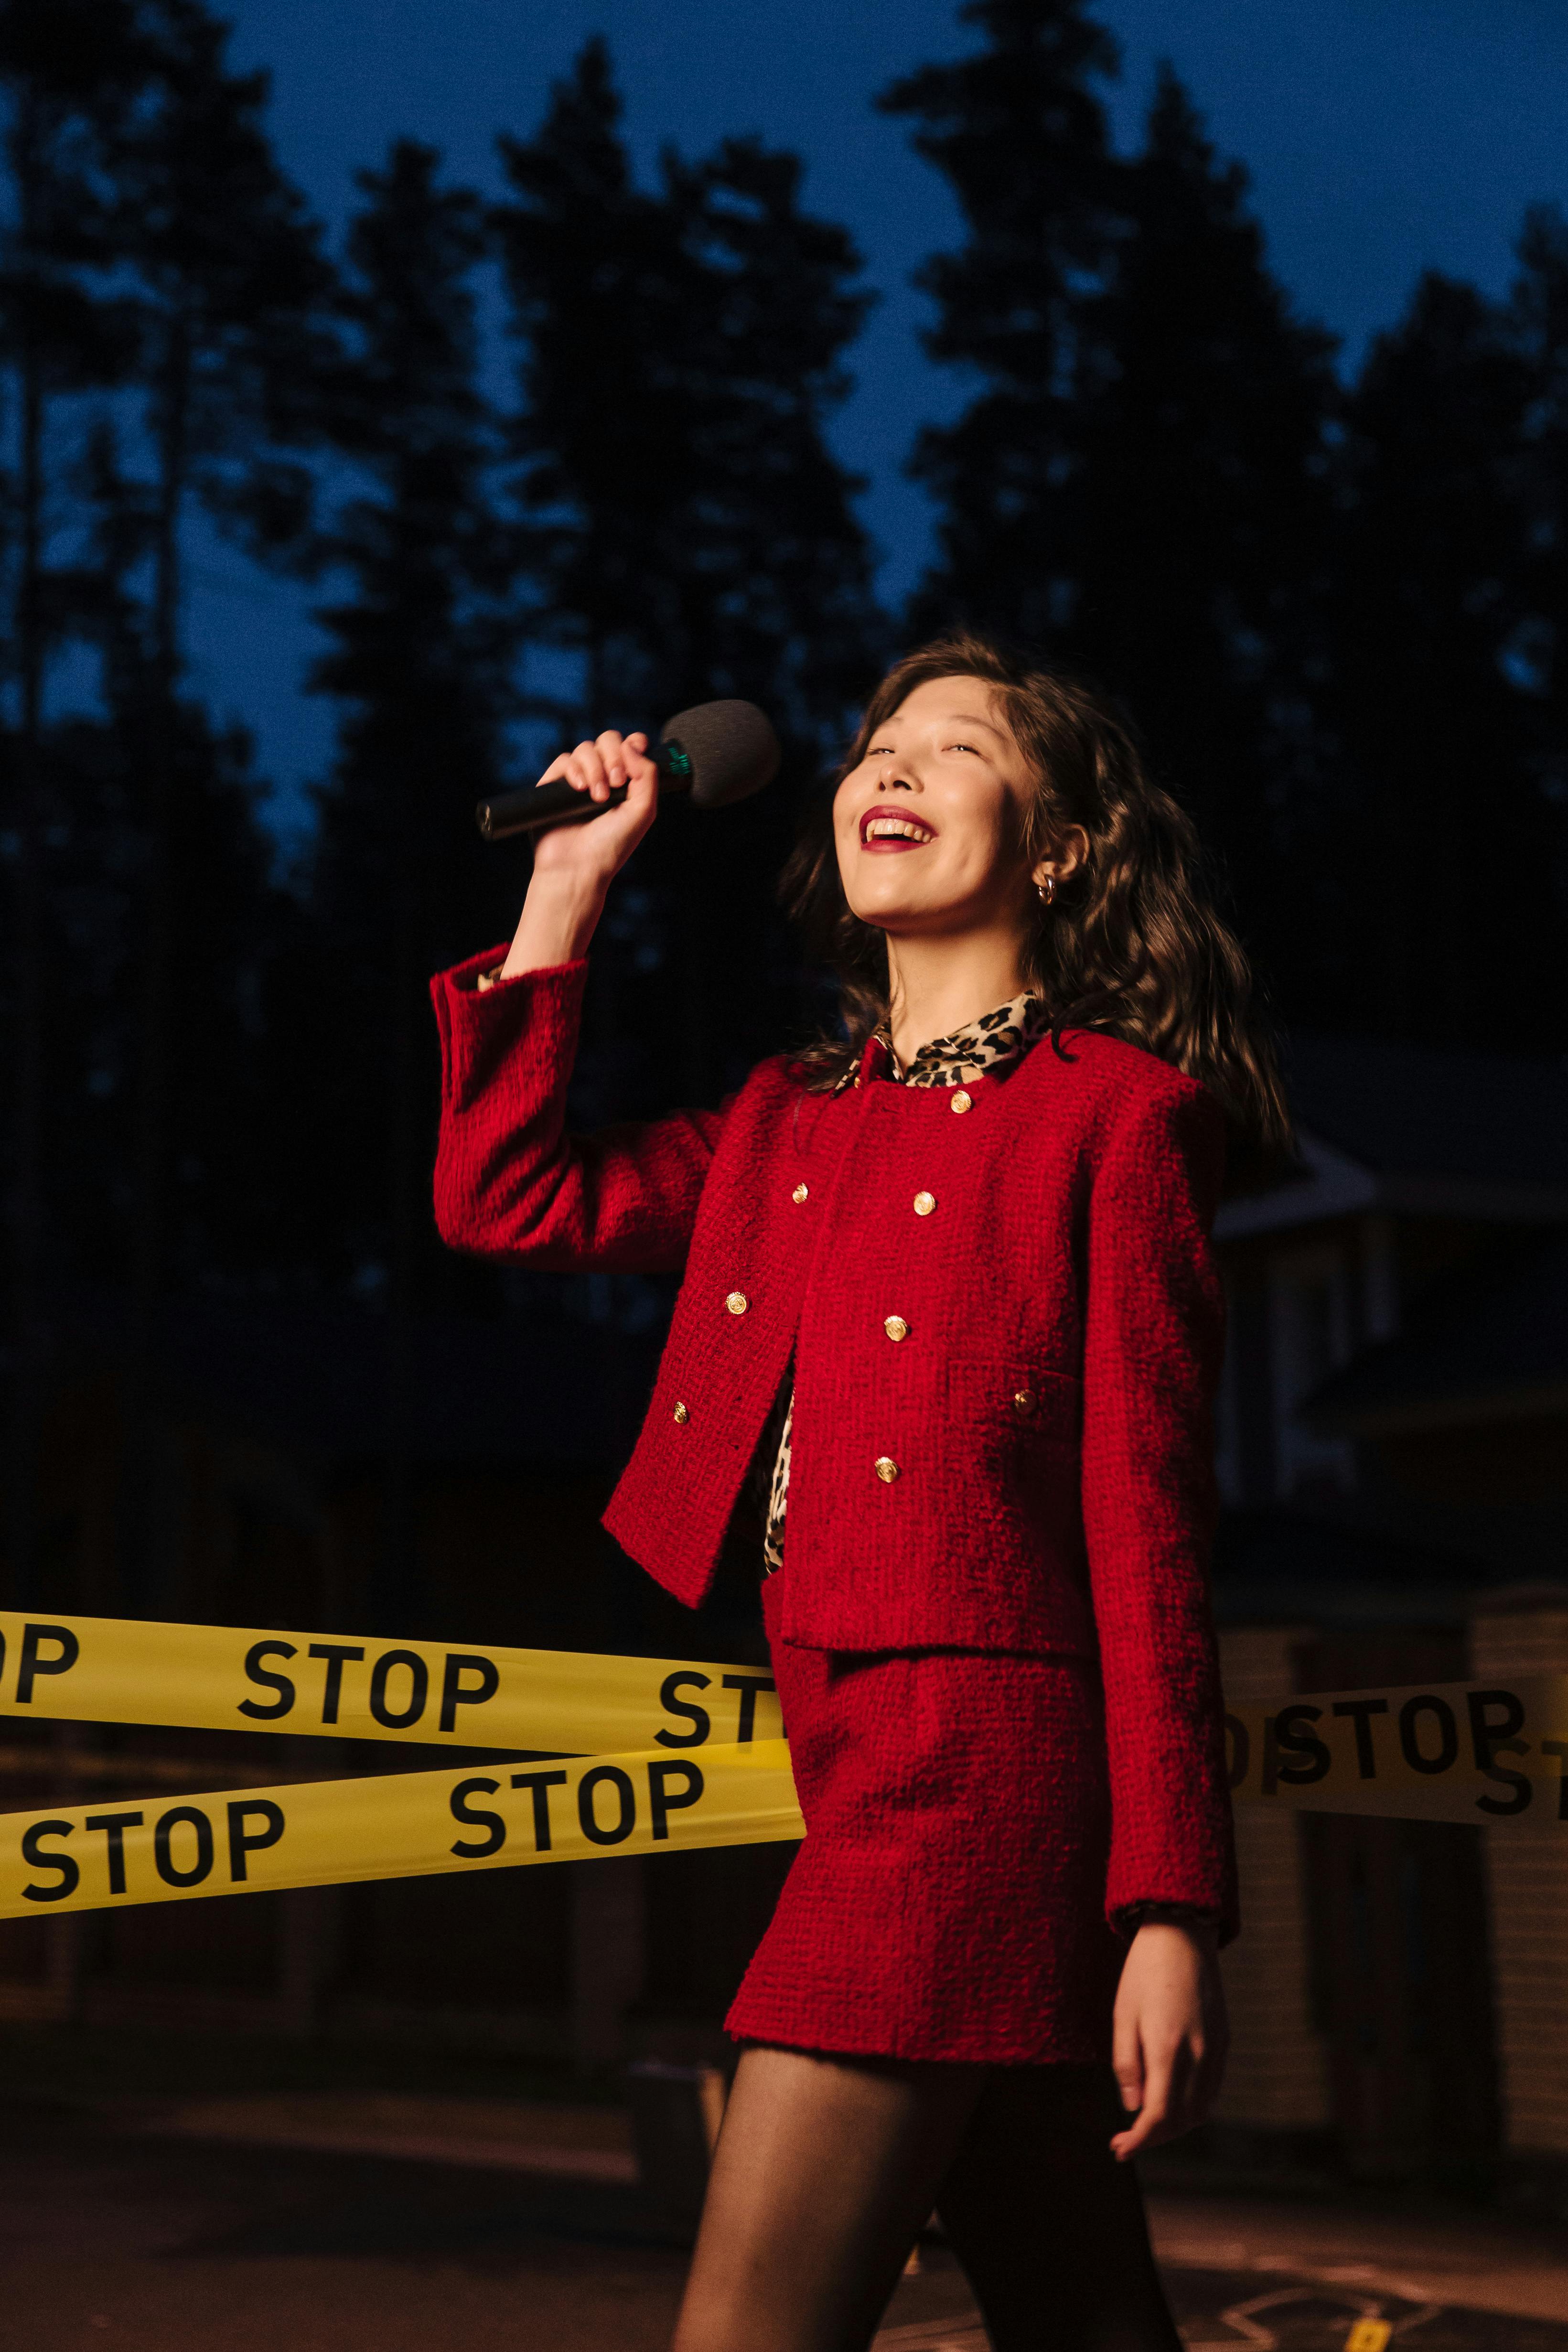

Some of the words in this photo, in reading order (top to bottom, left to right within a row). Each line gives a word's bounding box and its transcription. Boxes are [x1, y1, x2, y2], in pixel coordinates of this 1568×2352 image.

[0, 1623, 79, 1703] P
[237, 1640, 499, 1732] STOP
[654, 1671, 788, 1749] ST
[1274, 1690, 1524, 1784] STOP
[21, 1799, 285, 1902] STOP
[450, 1760, 704, 1858] STOP
